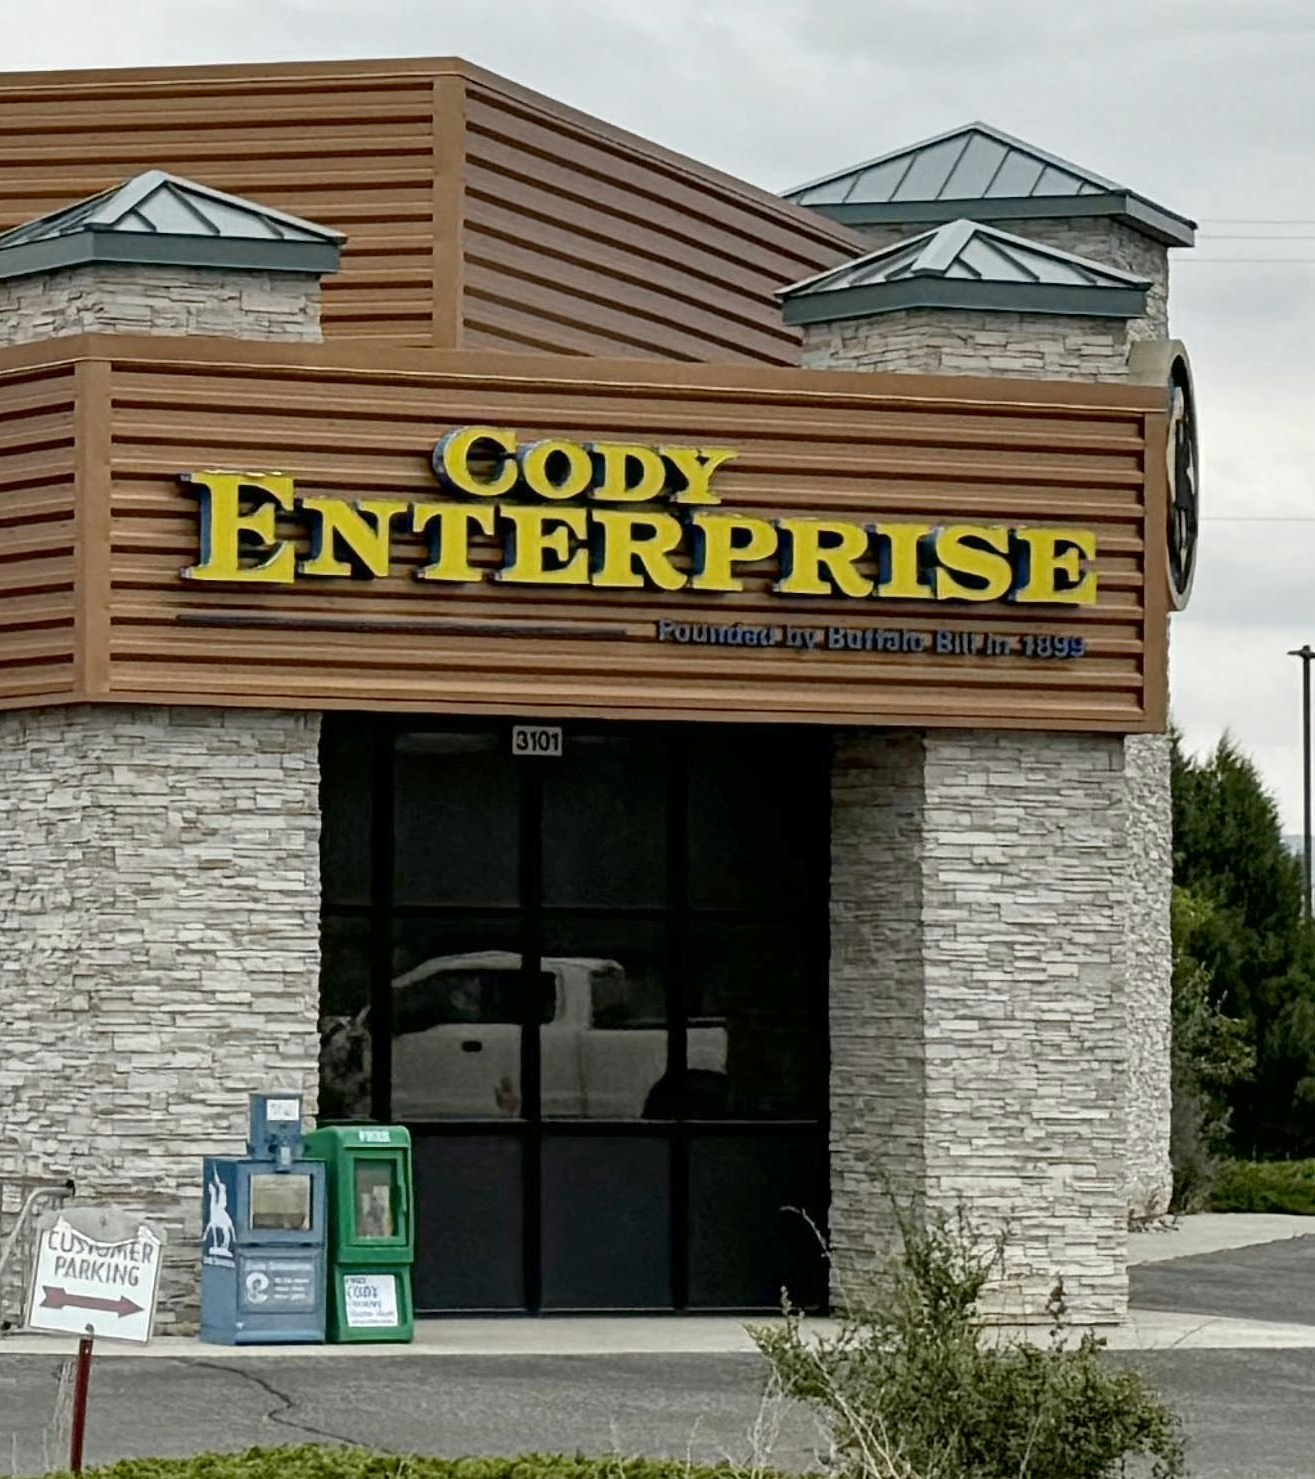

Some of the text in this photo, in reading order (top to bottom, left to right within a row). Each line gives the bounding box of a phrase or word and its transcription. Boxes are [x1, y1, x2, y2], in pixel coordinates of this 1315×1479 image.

[433, 426, 738, 505] CODY
[180, 470, 1098, 604] ENTERPRISE
[659, 619, 1085, 658] Founded by Buffalo Bill in 1899
[516, 730, 559, 752] 3101
[54, 1255, 140, 1287] PARKING
